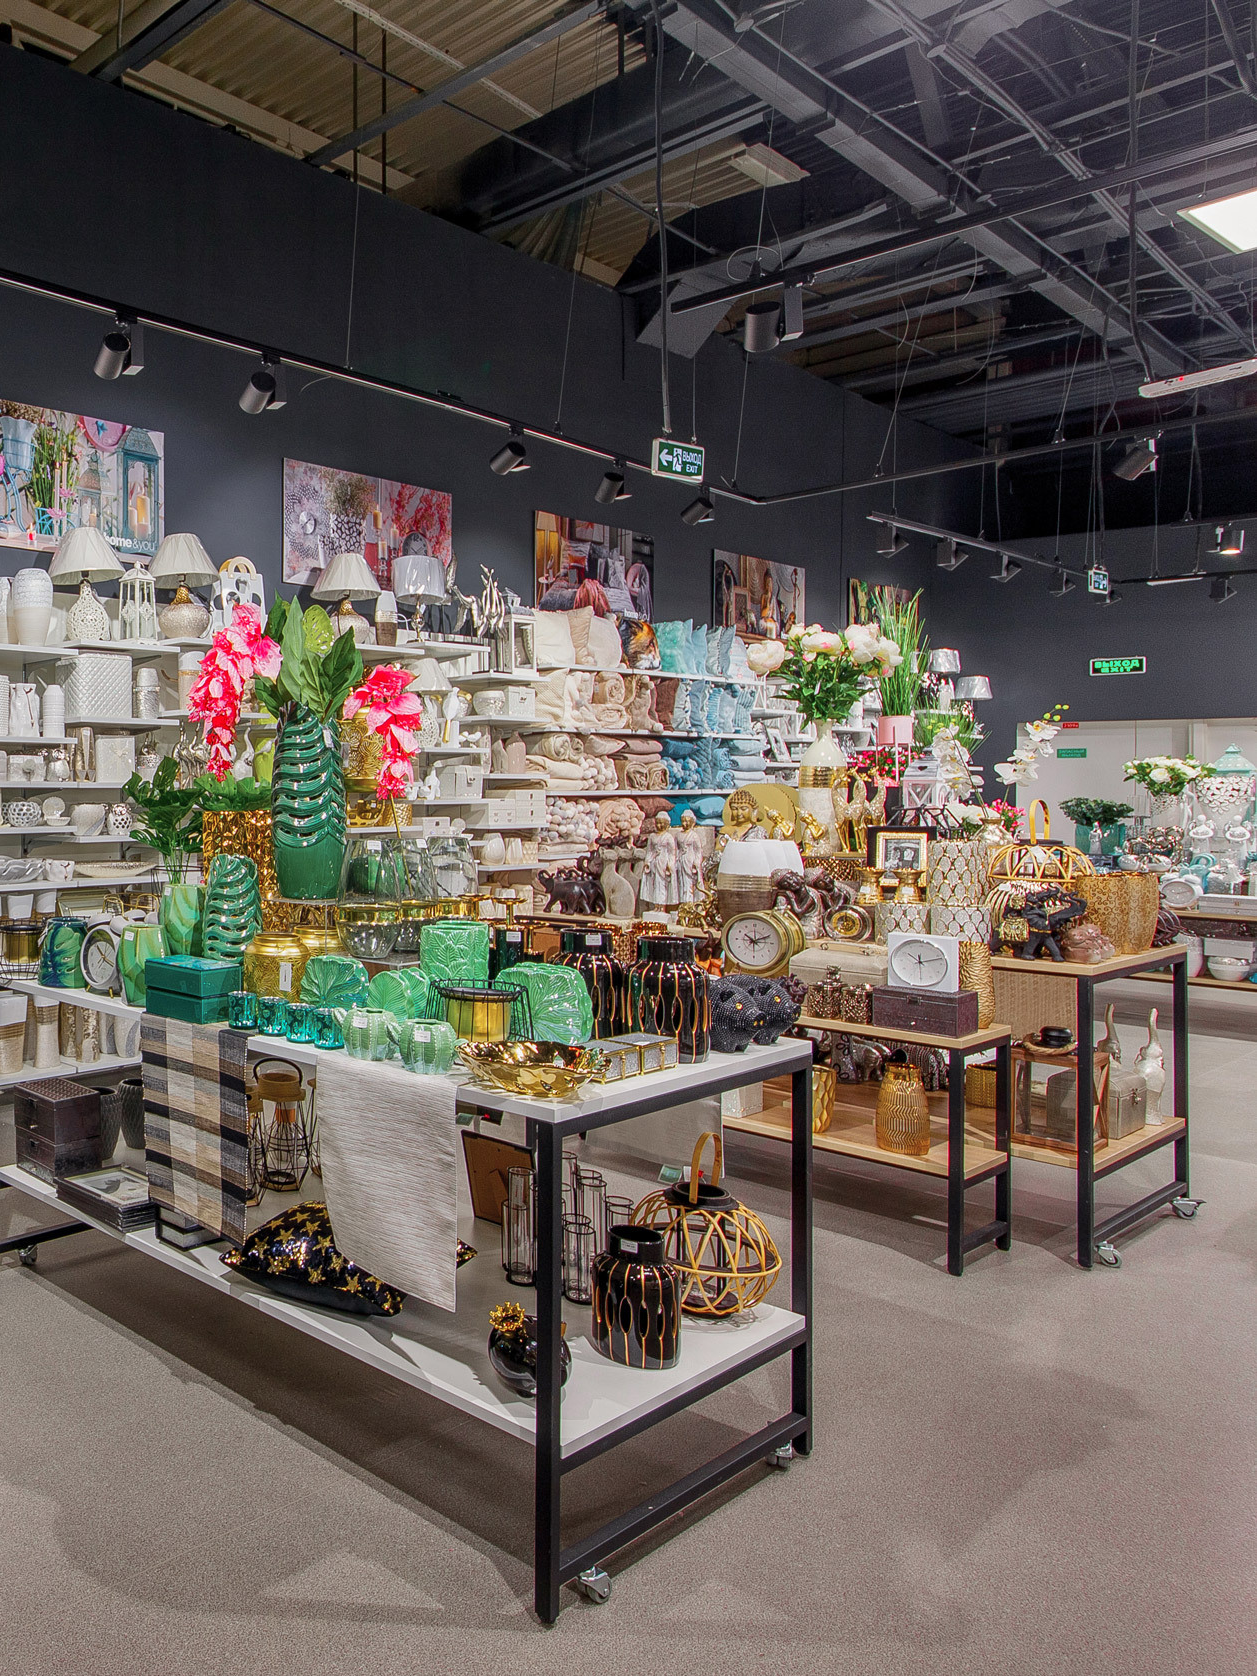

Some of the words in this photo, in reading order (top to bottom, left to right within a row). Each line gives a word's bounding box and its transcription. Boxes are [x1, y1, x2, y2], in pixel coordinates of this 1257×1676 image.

[682, 450, 702, 466] ВЫХОД
[686, 464, 698, 474] EXIT
[1094, 659, 1140, 669] ВЫХОД
